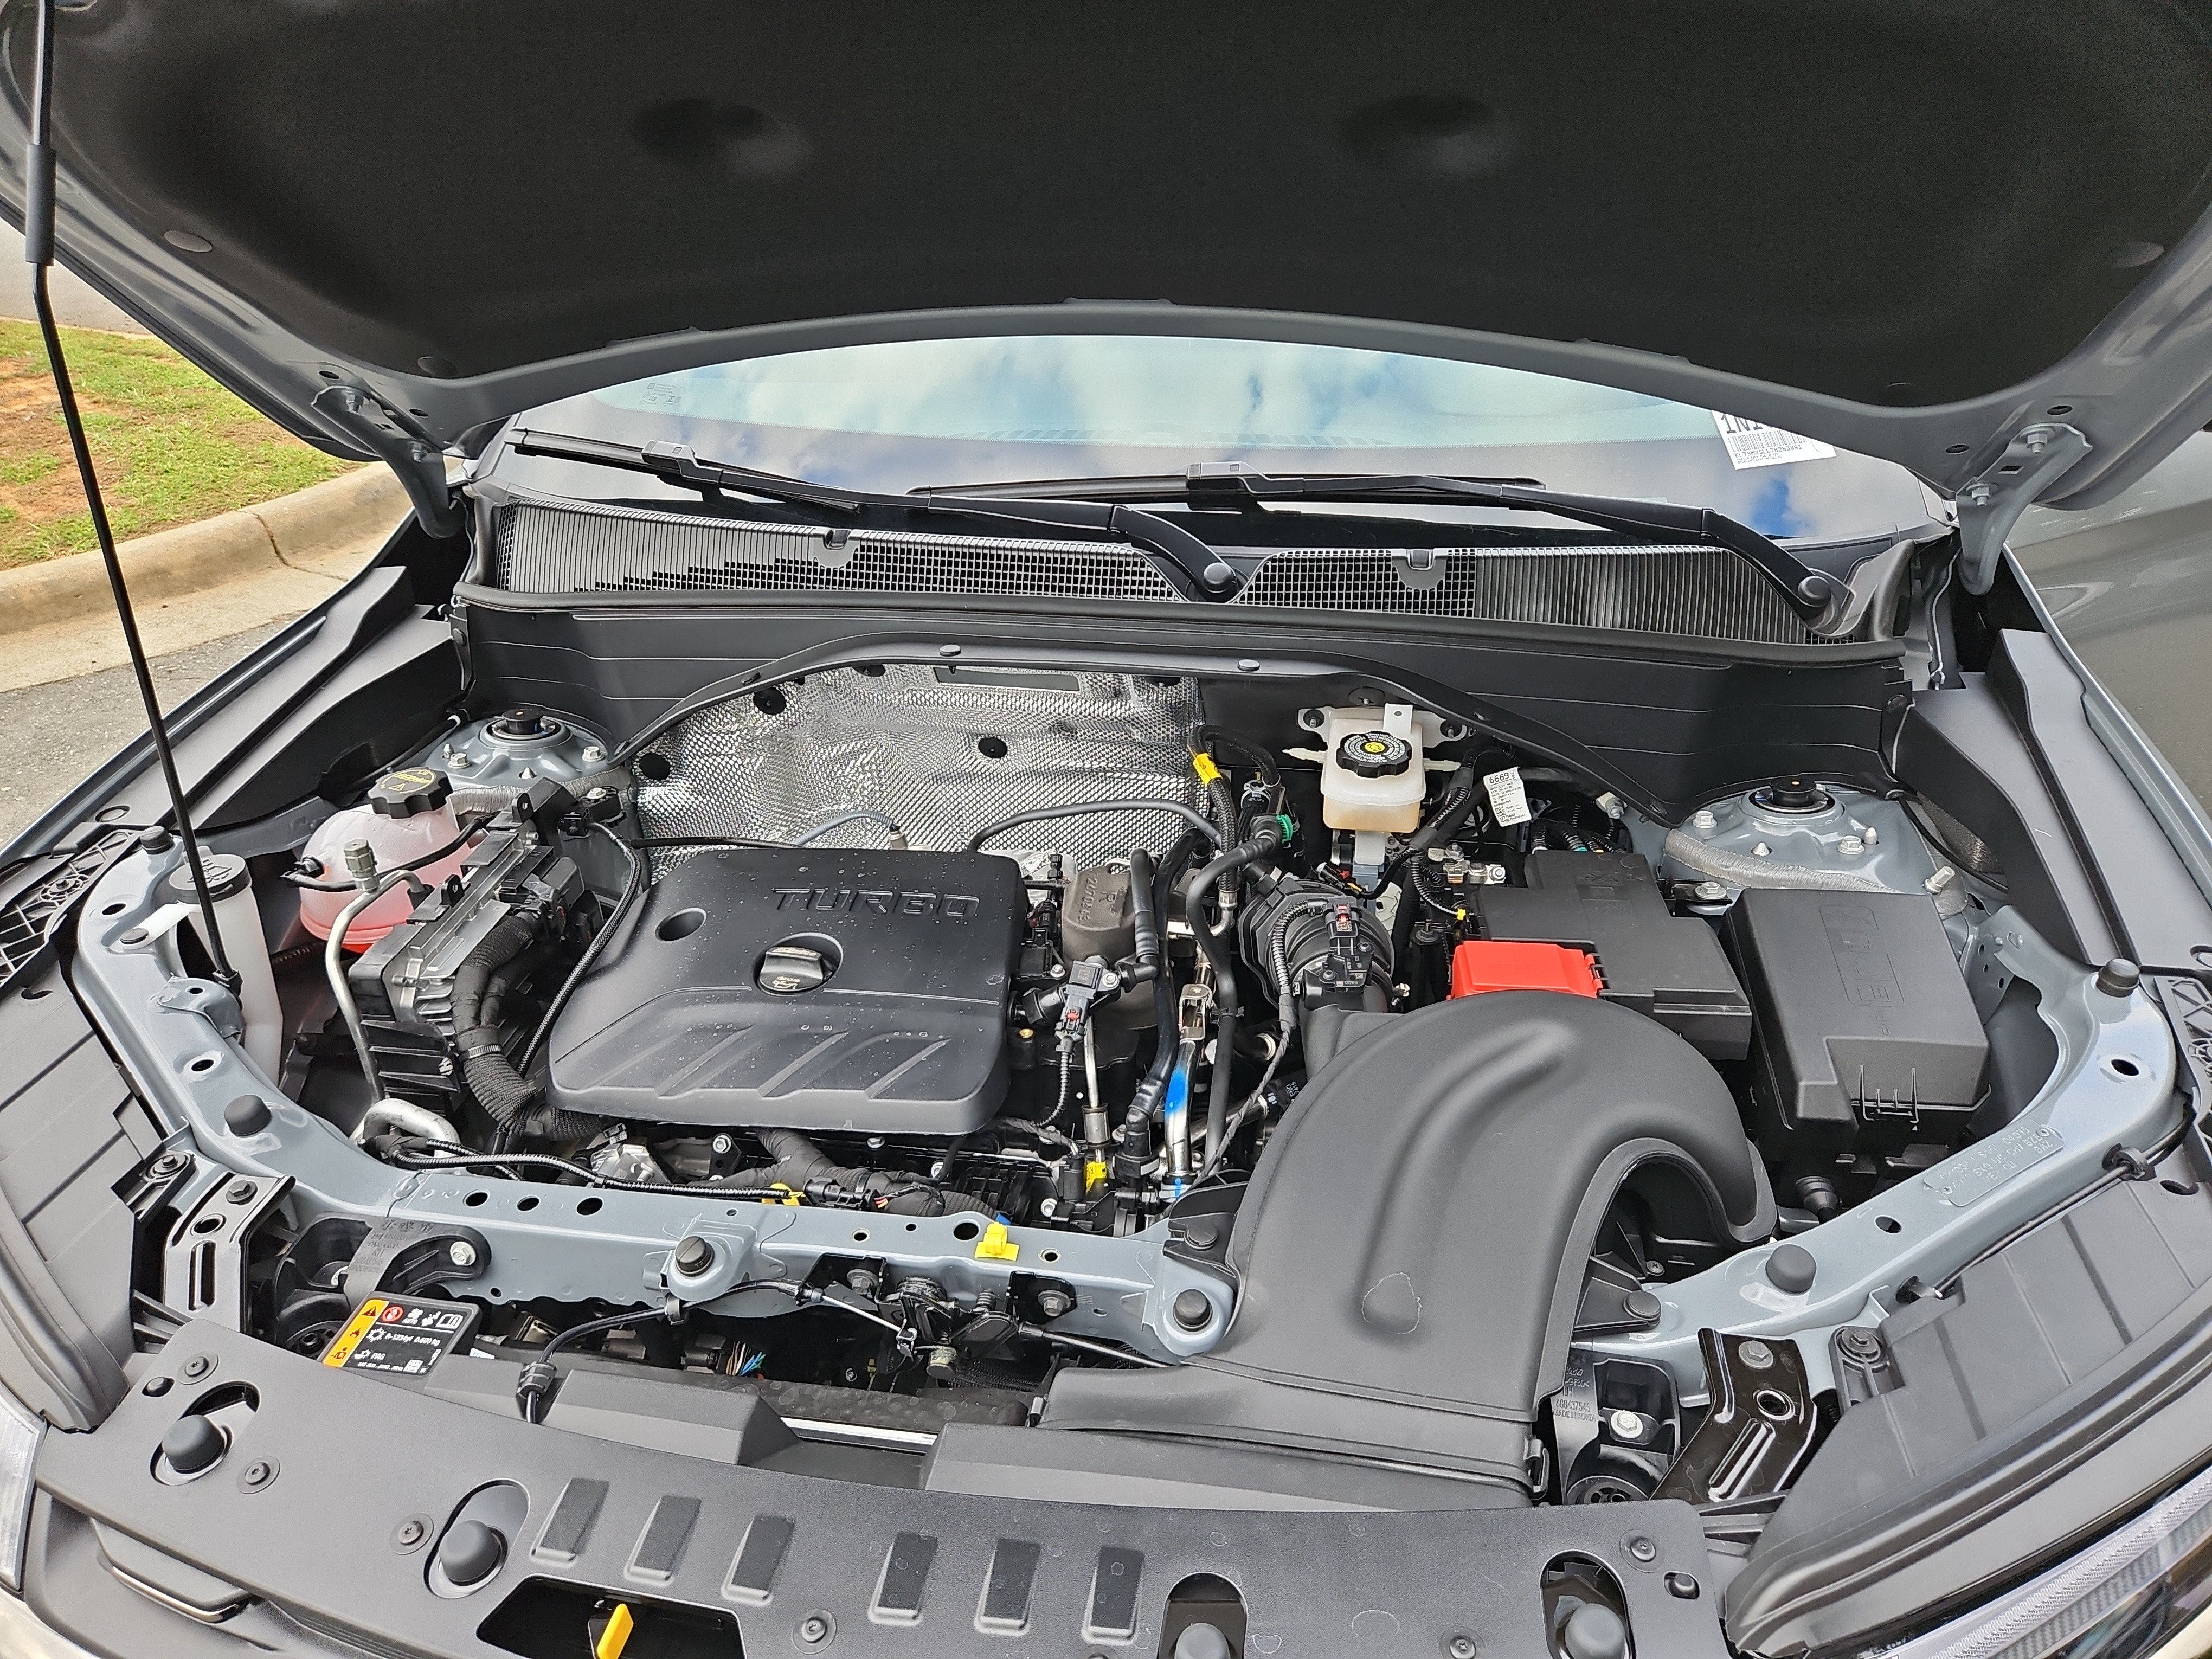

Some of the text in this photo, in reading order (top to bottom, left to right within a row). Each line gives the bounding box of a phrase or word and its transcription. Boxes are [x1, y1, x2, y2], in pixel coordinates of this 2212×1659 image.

[1489, 773, 1509, 784] 6669
[771, 888, 980, 918] TURBO
[1285, 1083, 1295, 1097] ENG
[370, 1352, 387, 1361] PAG
[1562, 1386, 1574, 1398] LH
